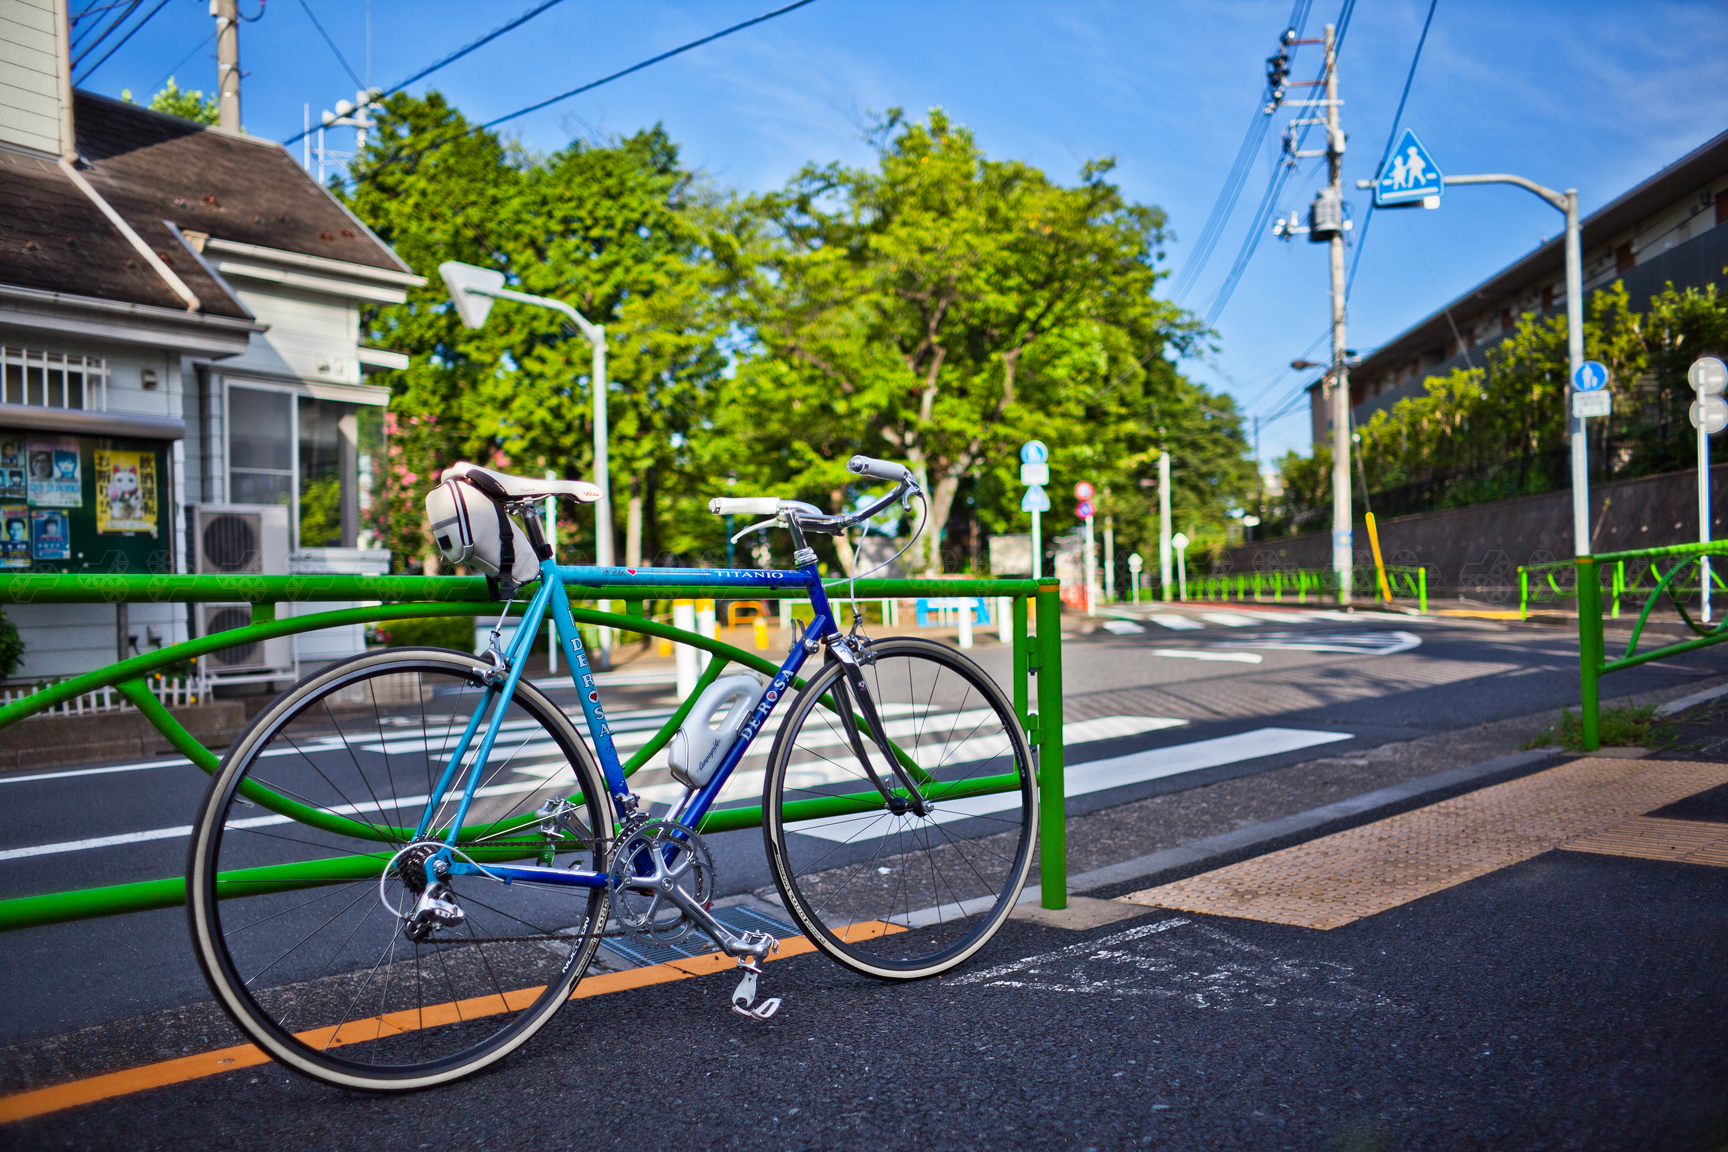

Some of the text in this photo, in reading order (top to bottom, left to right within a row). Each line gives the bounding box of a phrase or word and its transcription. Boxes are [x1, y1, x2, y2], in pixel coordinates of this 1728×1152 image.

[714, 570, 784, 579] TITANIO
[570, 637, 612, 738] DE ROSA
[740, 669, 795, 742] DE ROSA
